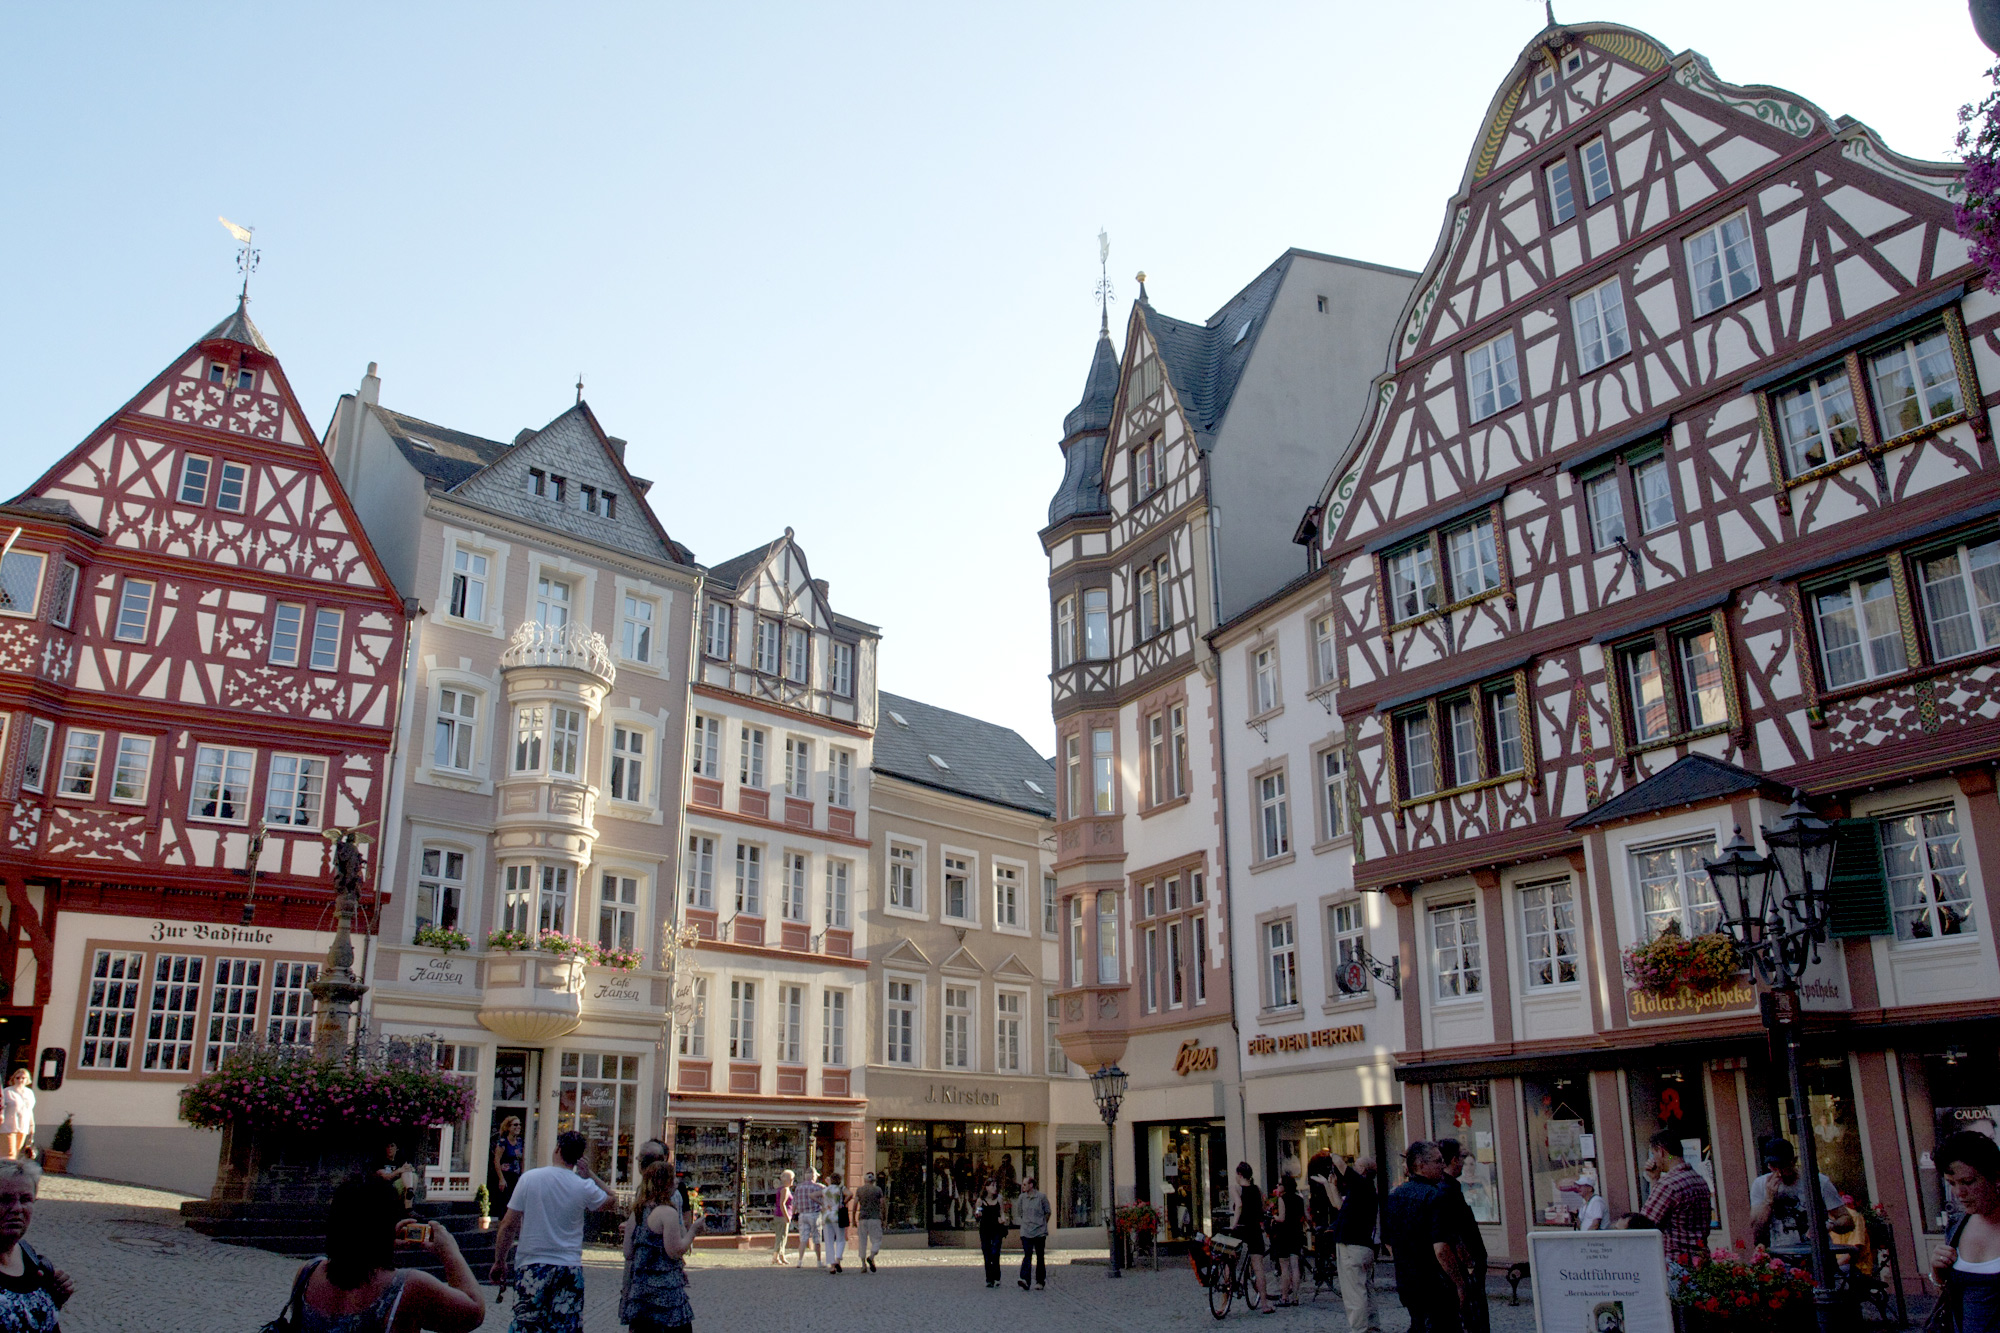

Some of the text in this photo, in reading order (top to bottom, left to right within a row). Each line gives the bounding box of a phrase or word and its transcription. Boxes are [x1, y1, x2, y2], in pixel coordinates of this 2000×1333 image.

[150, 921, 187, 941] Zur
[429, 958, 454, 971] Café
[409, 967, 463, 985] Hansen
[610, 977, 632, 988] Café
[594, 985, 640, 1001] Hansen
[1248, 1024, 1365, 1056] FÜR DEN HERRN
[925, 1085, 1001, 1106] J. Kirsten
[1559, 1269, 1640, 1283] Stadtführung
